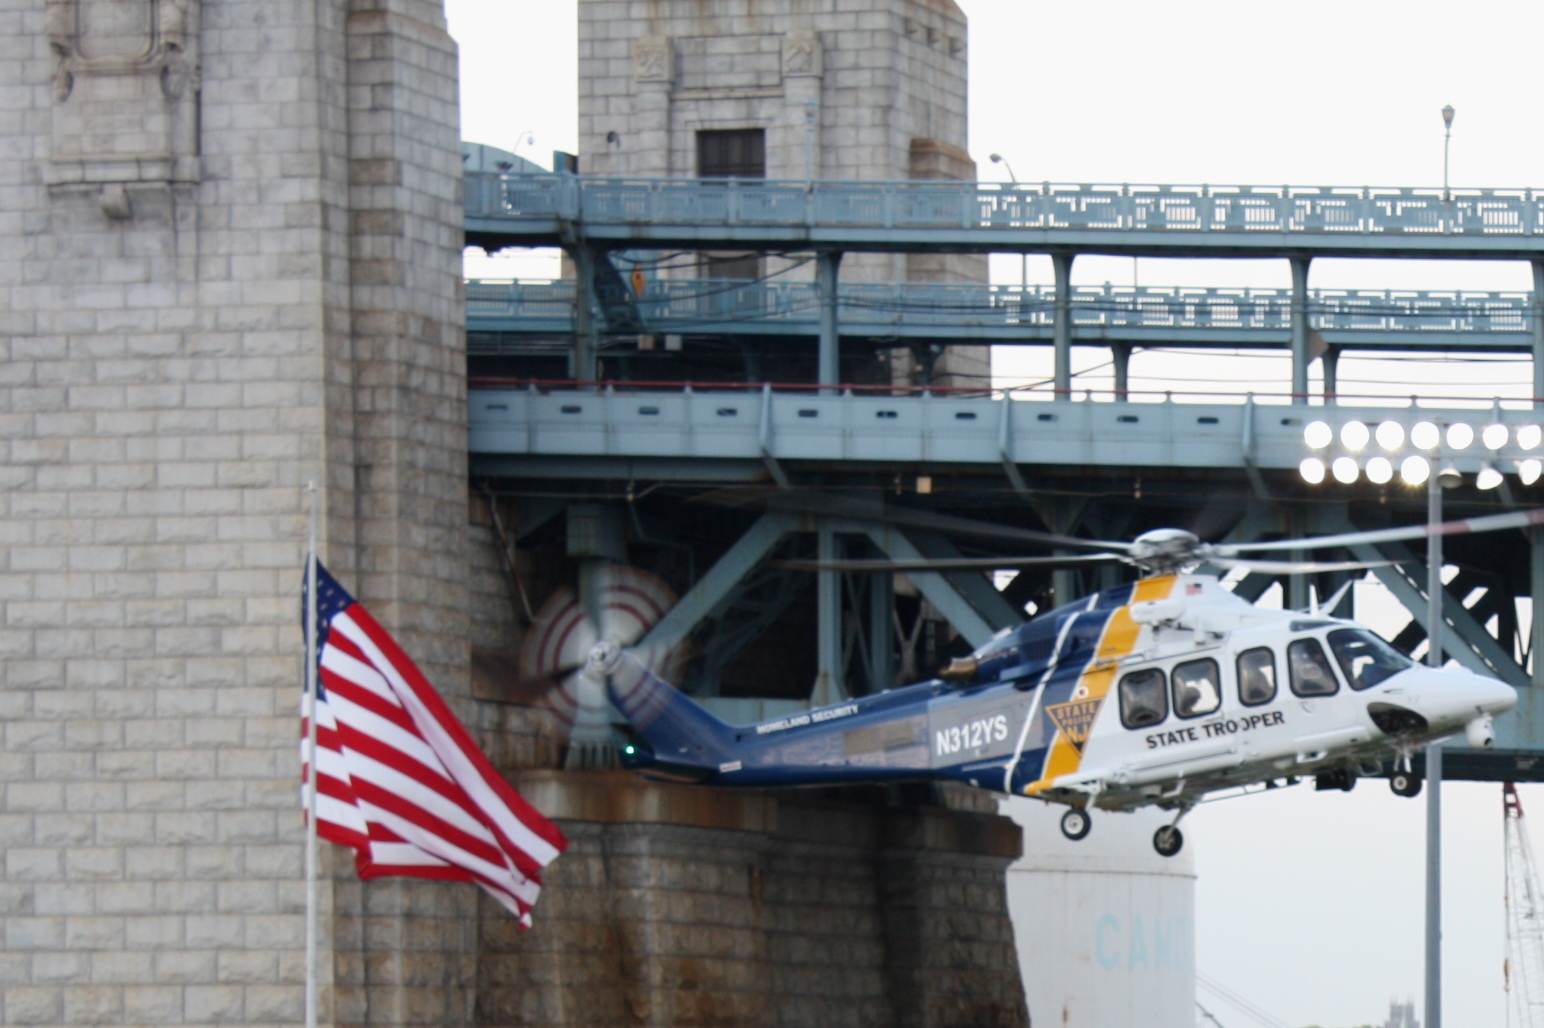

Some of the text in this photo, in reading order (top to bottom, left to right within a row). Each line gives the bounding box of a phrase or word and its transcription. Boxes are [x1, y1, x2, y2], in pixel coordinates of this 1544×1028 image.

[756, 704, 859, 734] HOMELAND SECURITY
[1057, 702, 1096, 719] STATE
[935, 714, 1008, 756] N312YS
[1146, 727, 1199, 749] STATE
